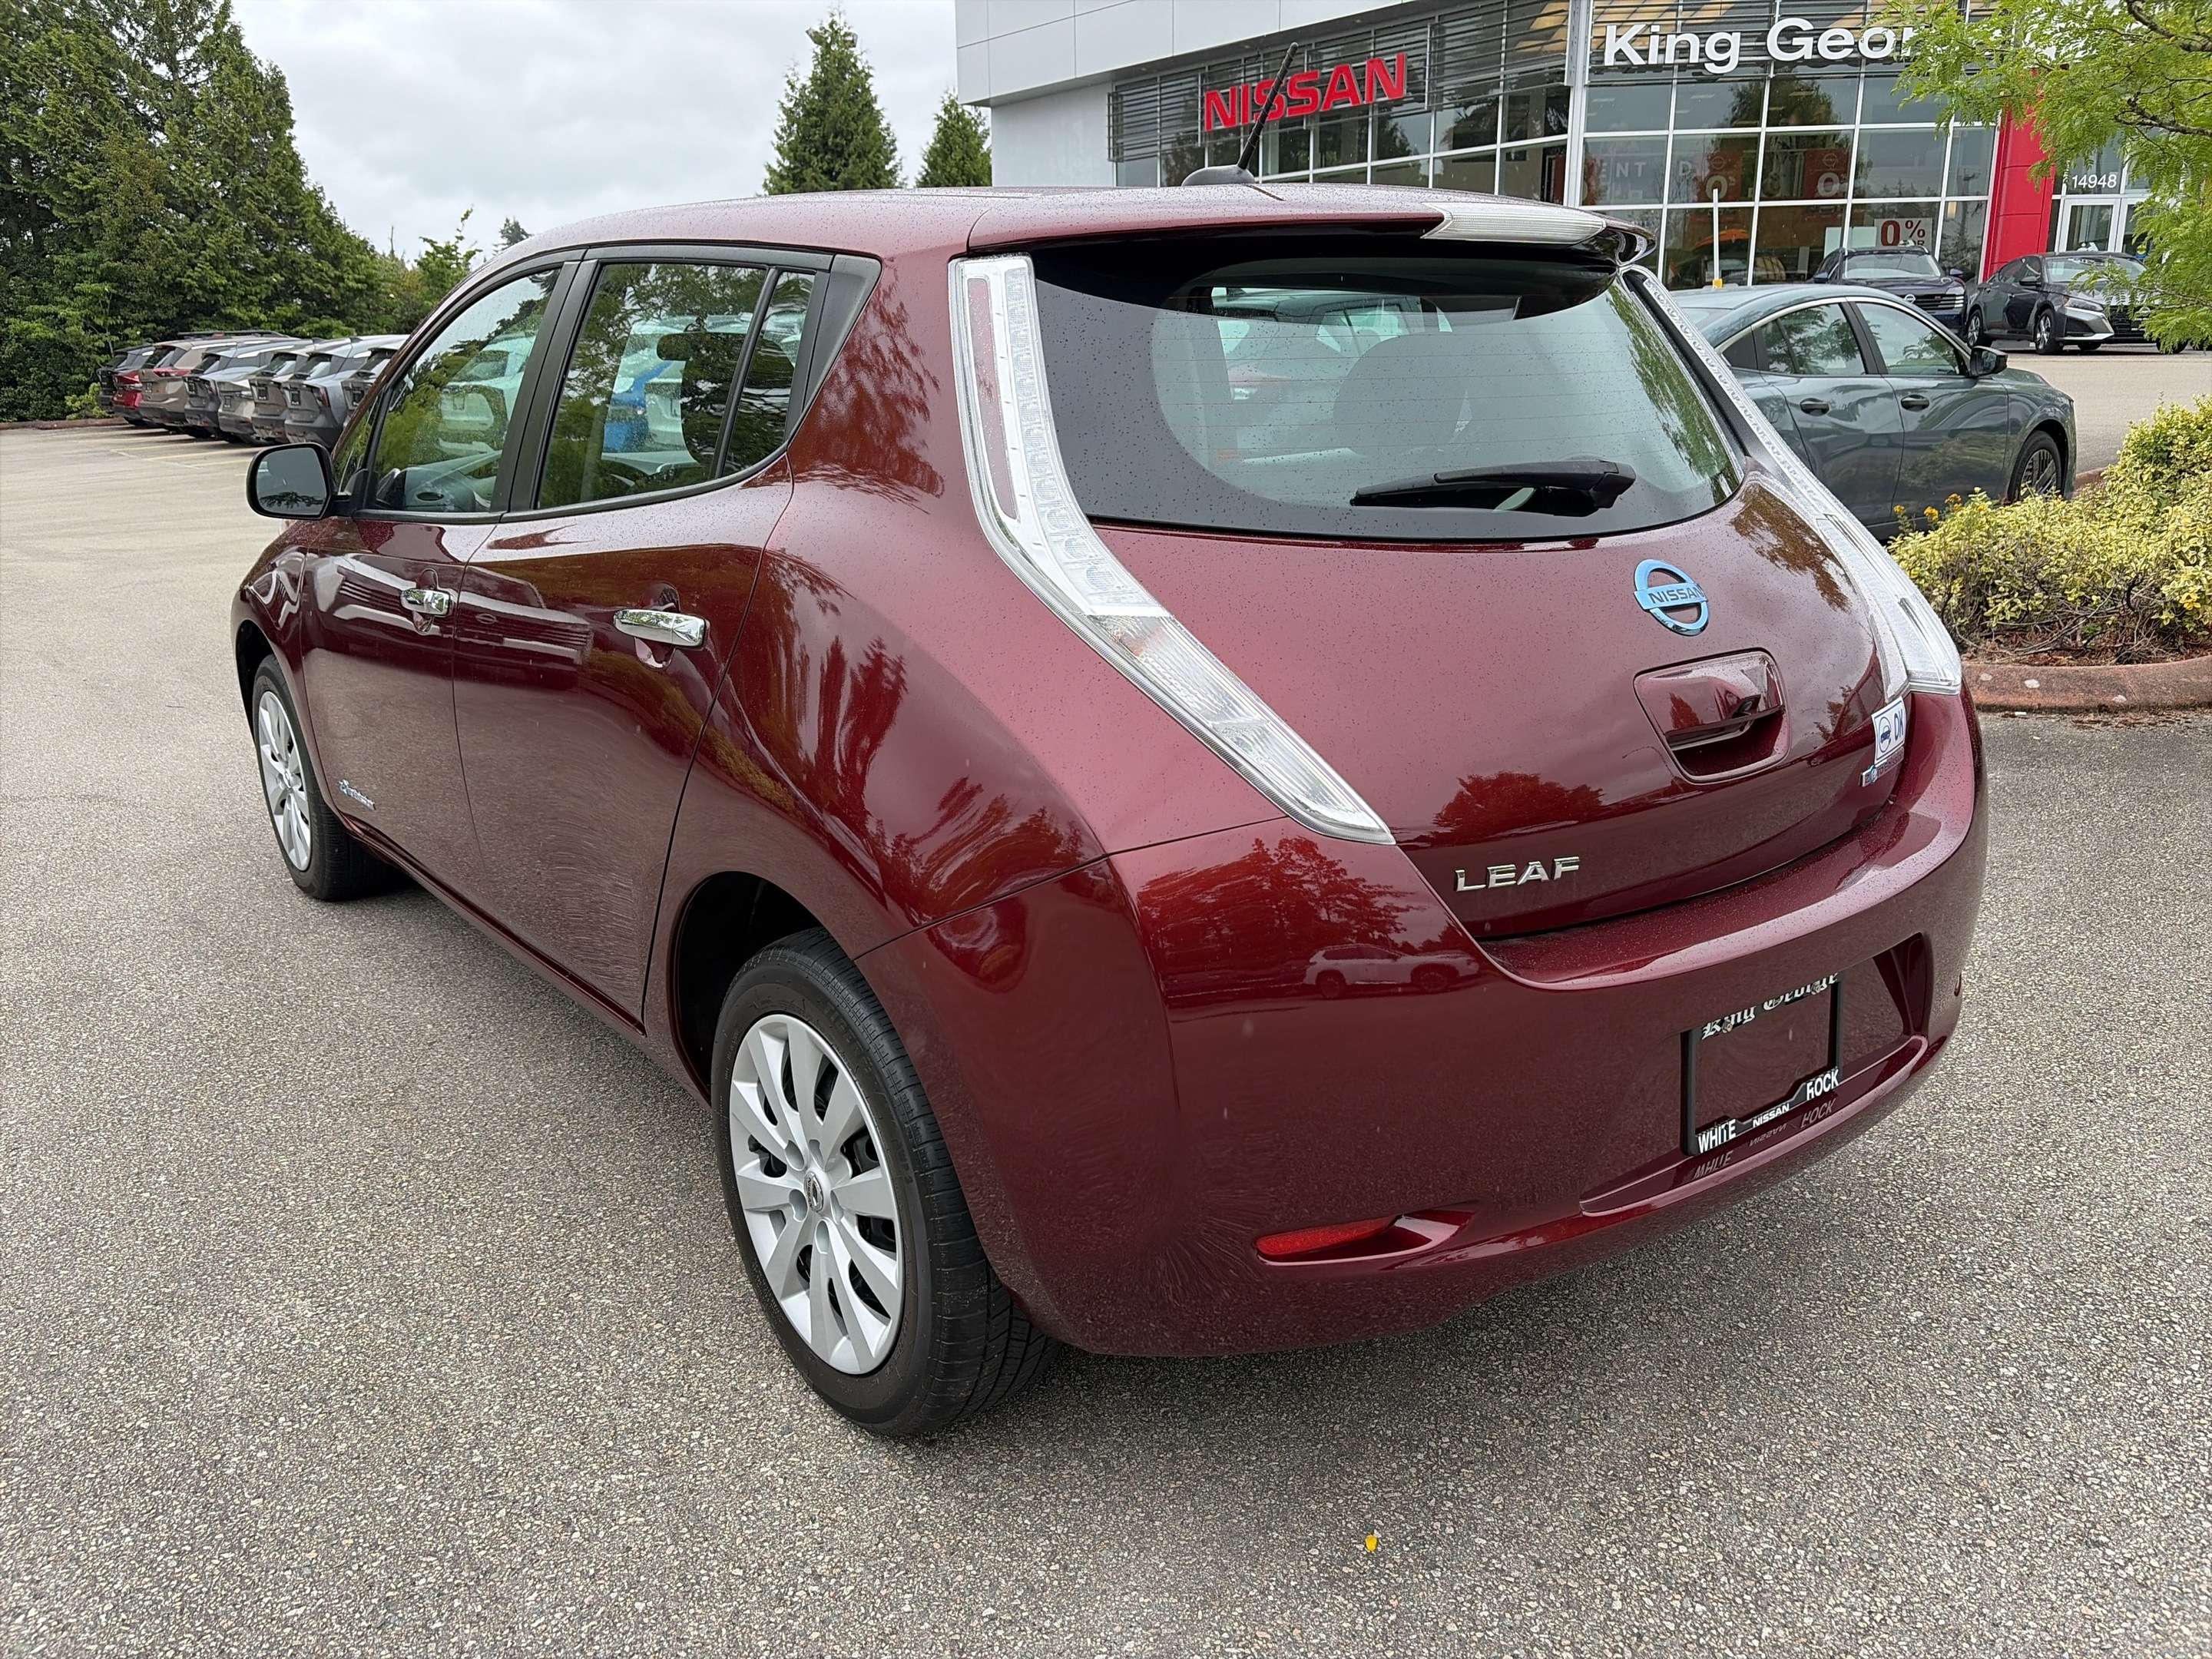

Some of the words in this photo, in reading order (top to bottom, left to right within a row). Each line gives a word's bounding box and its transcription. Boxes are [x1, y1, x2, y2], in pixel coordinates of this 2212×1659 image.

[1604, 24, 1741, 74] King
[1204, 52, 1407, 132] NISSAN
[2072, 174, 2117, 189] 14948
[1648, 585, 1705, 604] NISSAN
[1454, 856, 1580, 892] LEAF
[1697, 1118, 1737, 1154] WHITE
[1753, 1103, 1790, 1128] NISSAN
[1806, 1068, 1839, 1101] ROCK
